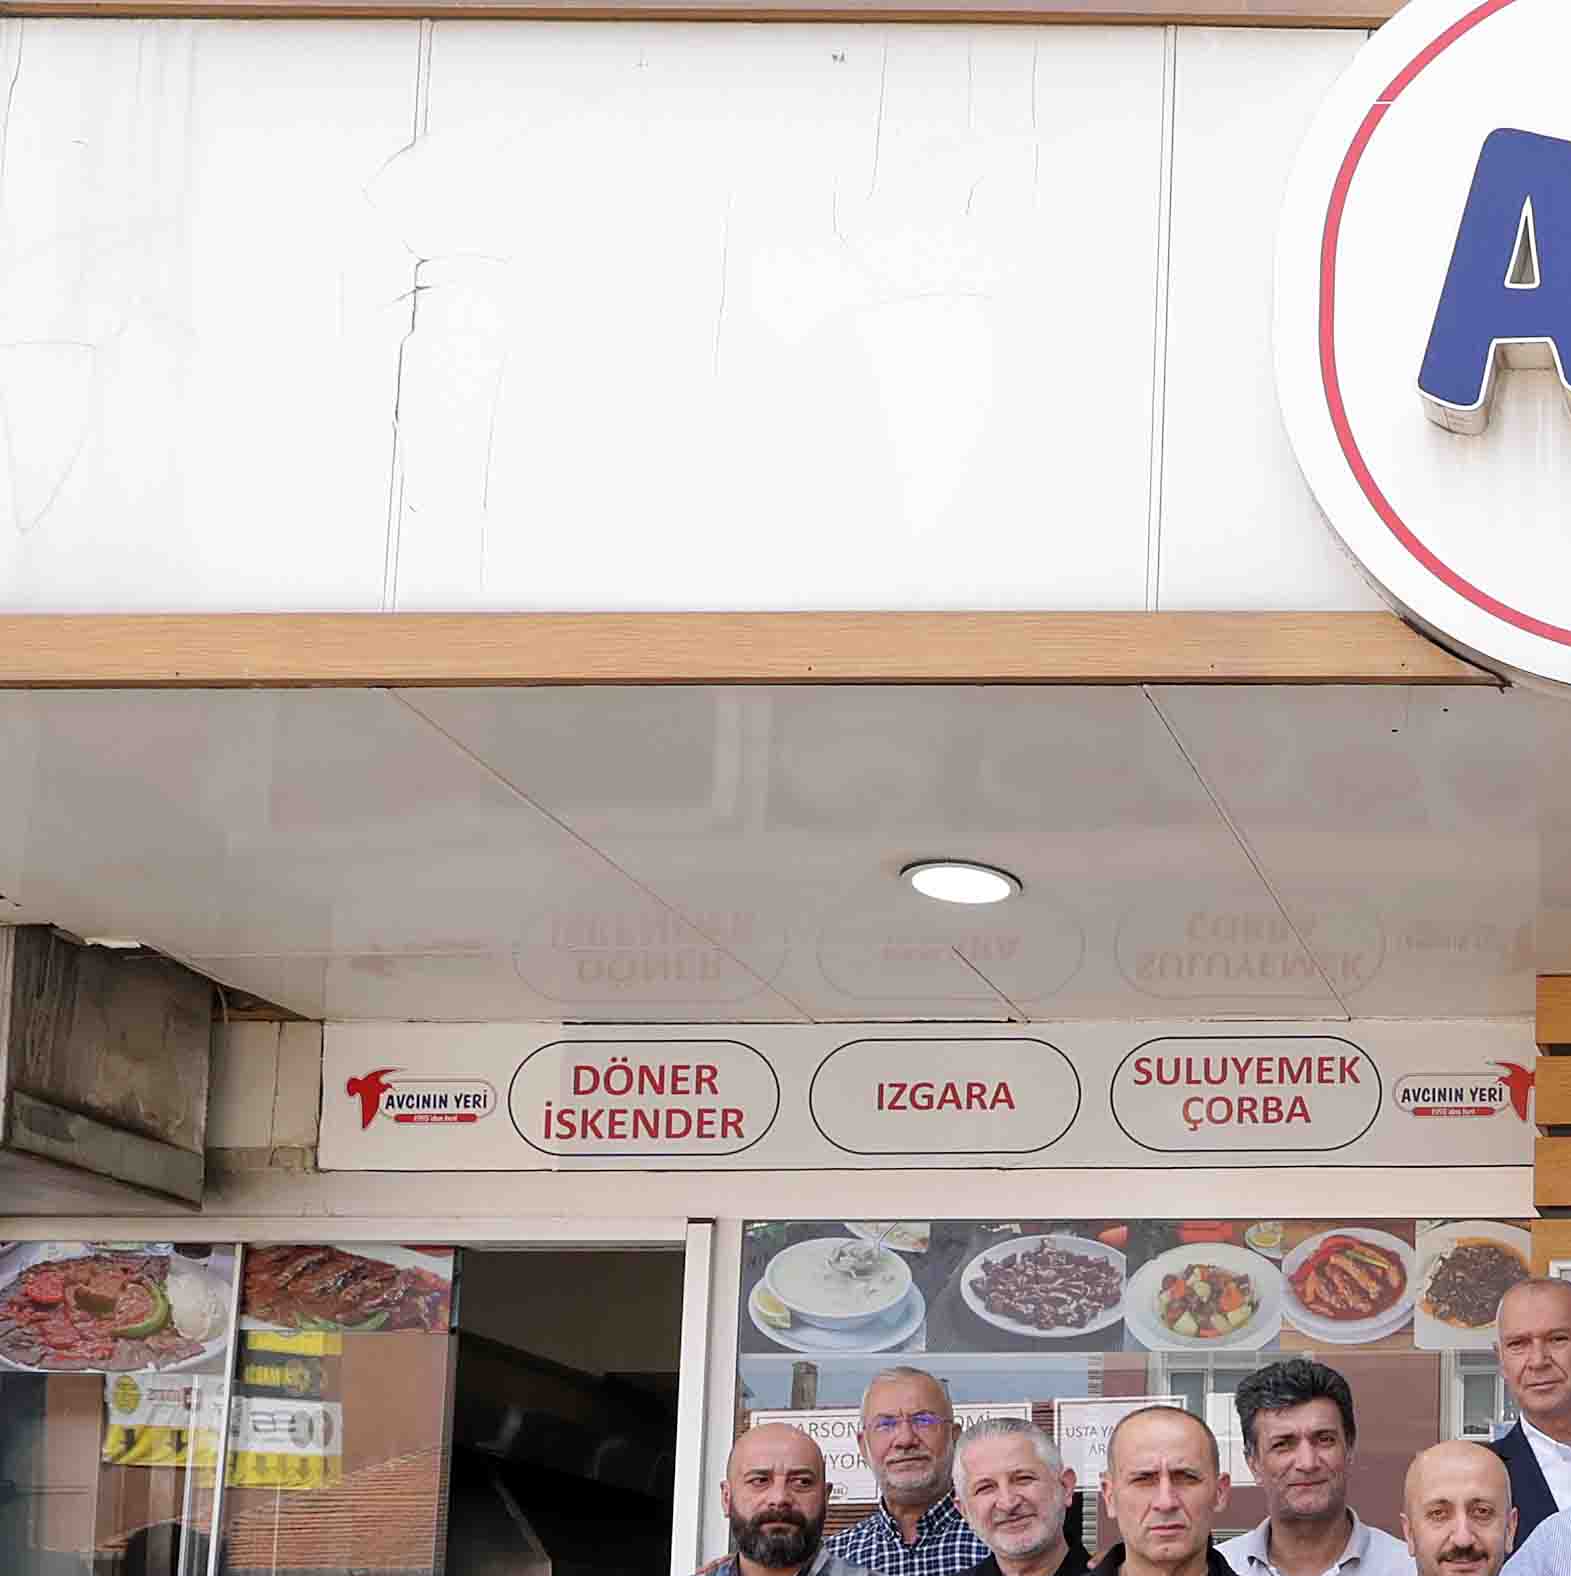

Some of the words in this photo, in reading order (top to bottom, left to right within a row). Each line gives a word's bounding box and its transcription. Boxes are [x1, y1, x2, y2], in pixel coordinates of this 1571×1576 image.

[571, 1057, 720, 1096] DÖNER
[1132, 1054, 1361, 1087] SULUYEMEK
[384, 1094, 449, 1110] AVCININ
[454, 1089, 488, 1109] YERİ
[874, 1081, 1016, 1113] IZGARA
[1401, 1087, 1464, 1103] AVCININ
[1469, 1083, 1502, 1102] YERİ
[543, 1099, 745, 1140] İSKENDER
[1181, 1095, 1313, 1132] ÇORBA
